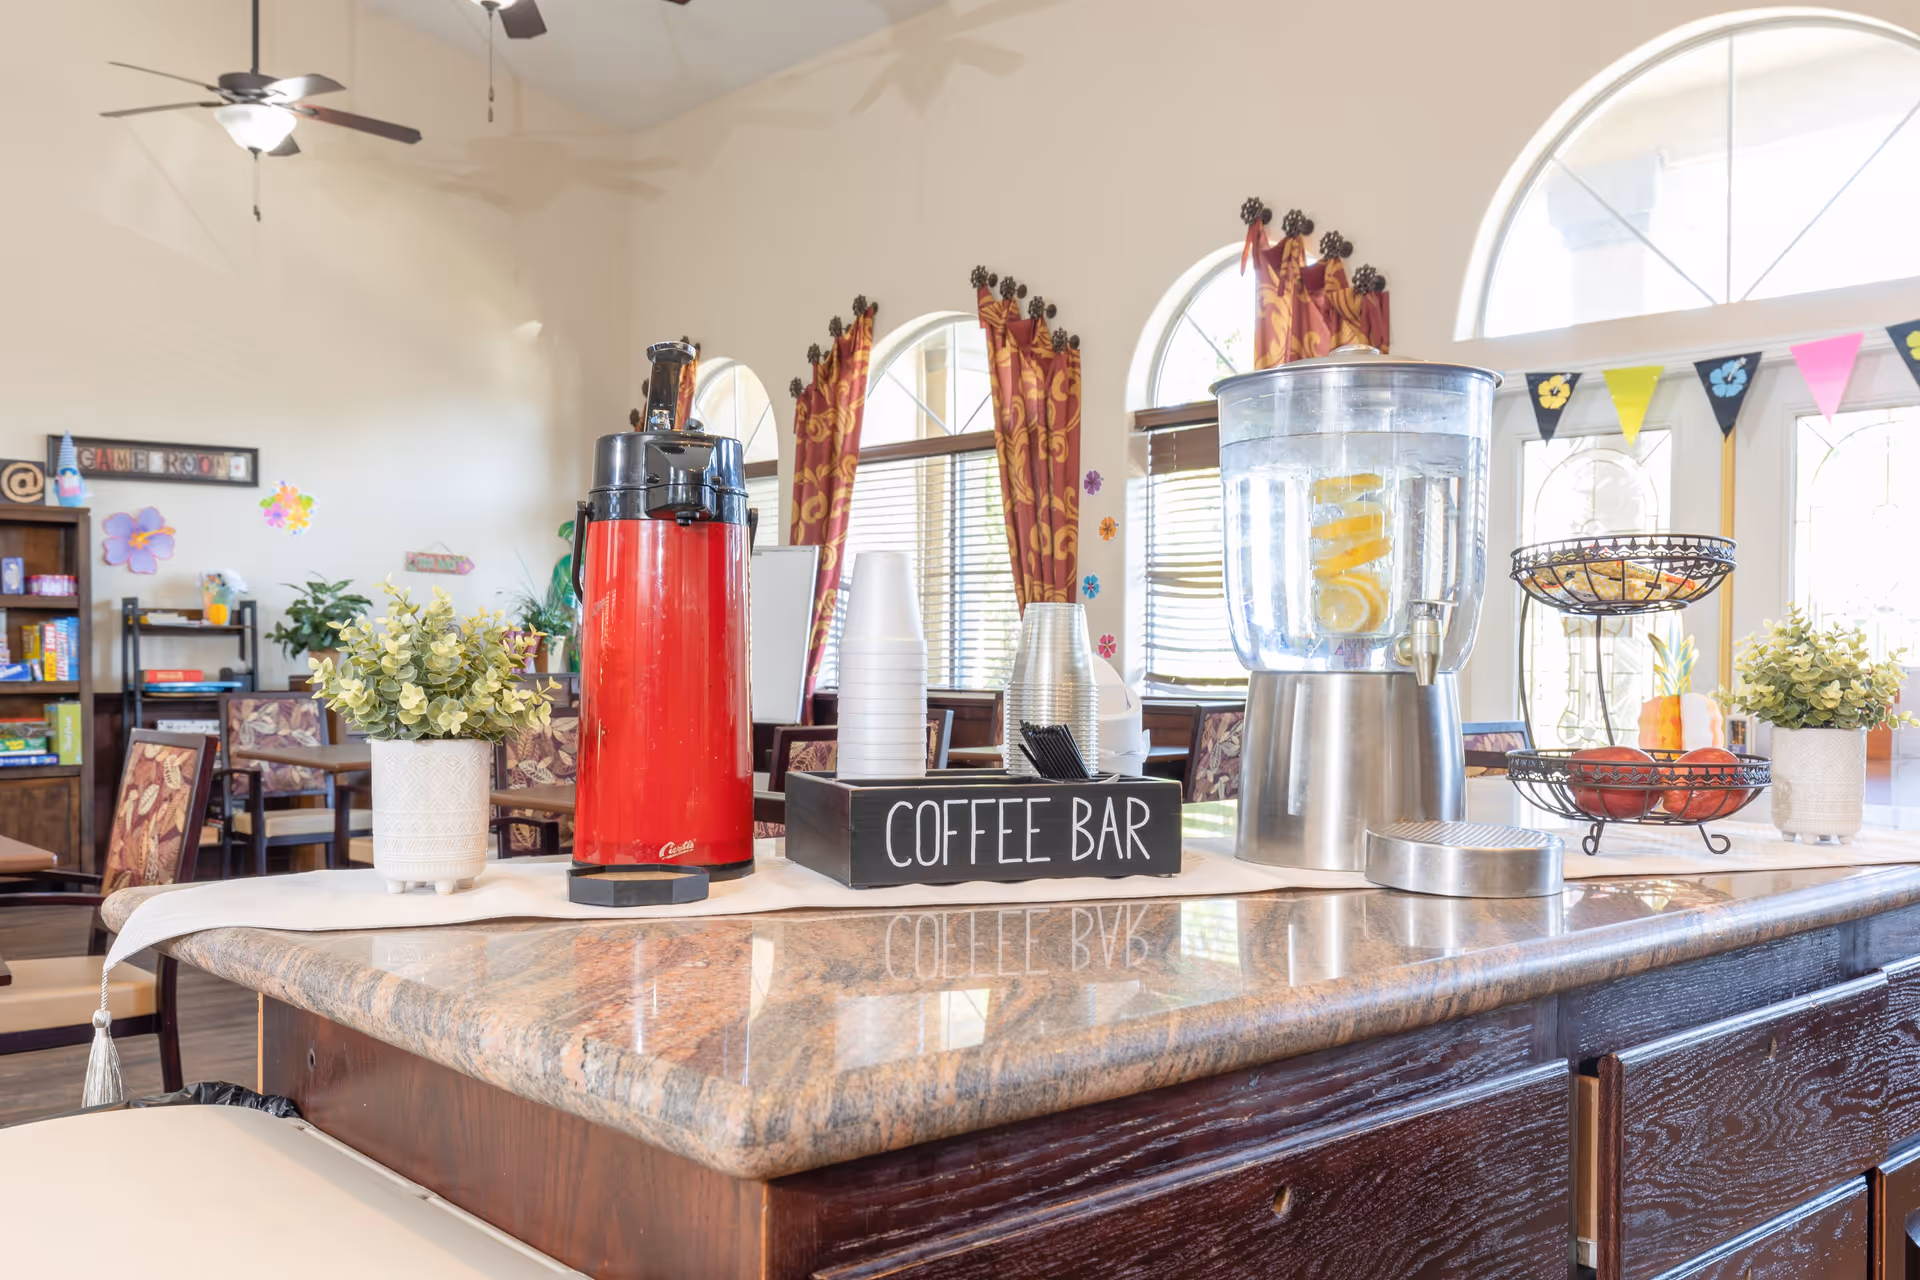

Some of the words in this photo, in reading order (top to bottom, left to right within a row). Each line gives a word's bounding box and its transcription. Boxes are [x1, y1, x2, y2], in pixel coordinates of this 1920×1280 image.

[78, 448, 148, 472] GAME
[886, 798, 1051, 867] COFFEE
[1072, 797, 1150, 861] BAR
